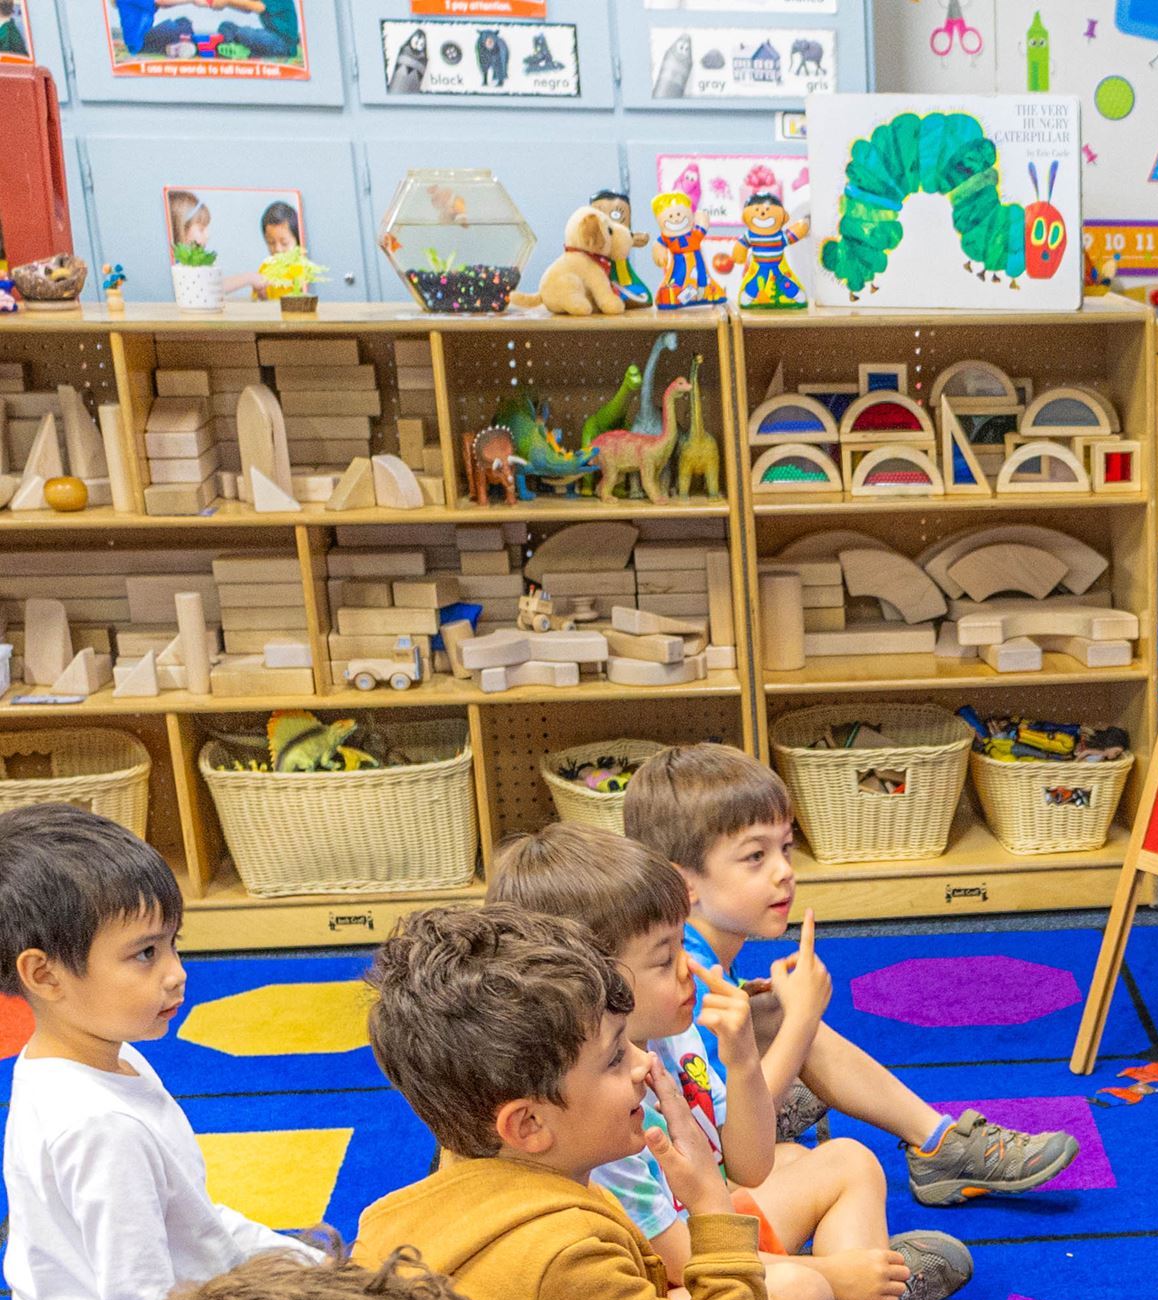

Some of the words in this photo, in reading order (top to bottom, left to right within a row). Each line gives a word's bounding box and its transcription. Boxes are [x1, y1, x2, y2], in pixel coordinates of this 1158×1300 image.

[469, 1, 512, 12] attention.
[179, 64, 207, 75] words
[429, 74, 464, 86] black
[698, 79, 727, 92] gray
[807, 79, 829, 92] gris
[1016, 104, 1039, 116] THE
[1040, 104, 1069, 116] VERY
[1023, 118, 1069, 129] HUNGRY
[994, 131, 1070, 143] CATERPILLAR
[1104, 233, 1125, 251] 10
[1135, 234, 1154, 251] 11
